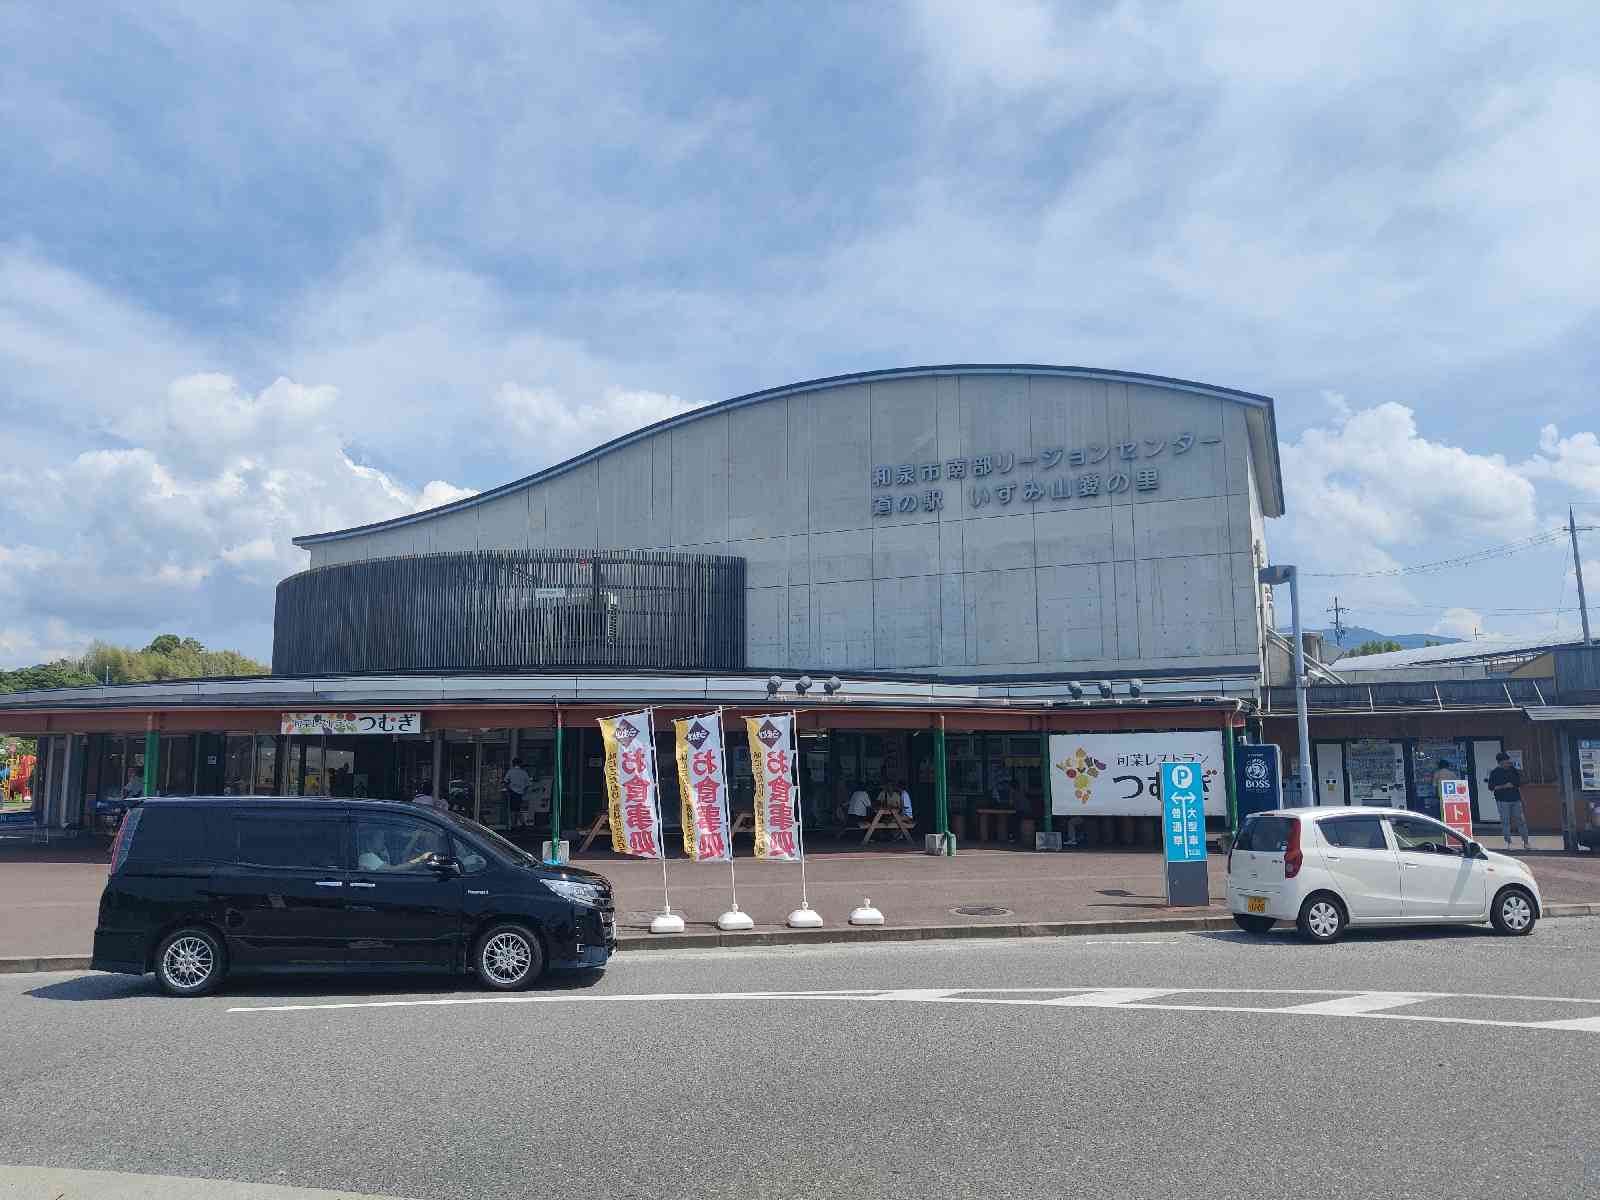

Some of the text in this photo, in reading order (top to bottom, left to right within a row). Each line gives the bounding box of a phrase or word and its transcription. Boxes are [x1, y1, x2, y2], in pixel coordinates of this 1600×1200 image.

[872, 432, 1222, 487] 和泉市南部リージョンセンター
[872, 488, 944, 516] 道の駅
[359, 713, 417, 732] つむぎ
[1246, 778, 1271, 789] BOSS
[1187, 807, 1199, 846] 大型車
